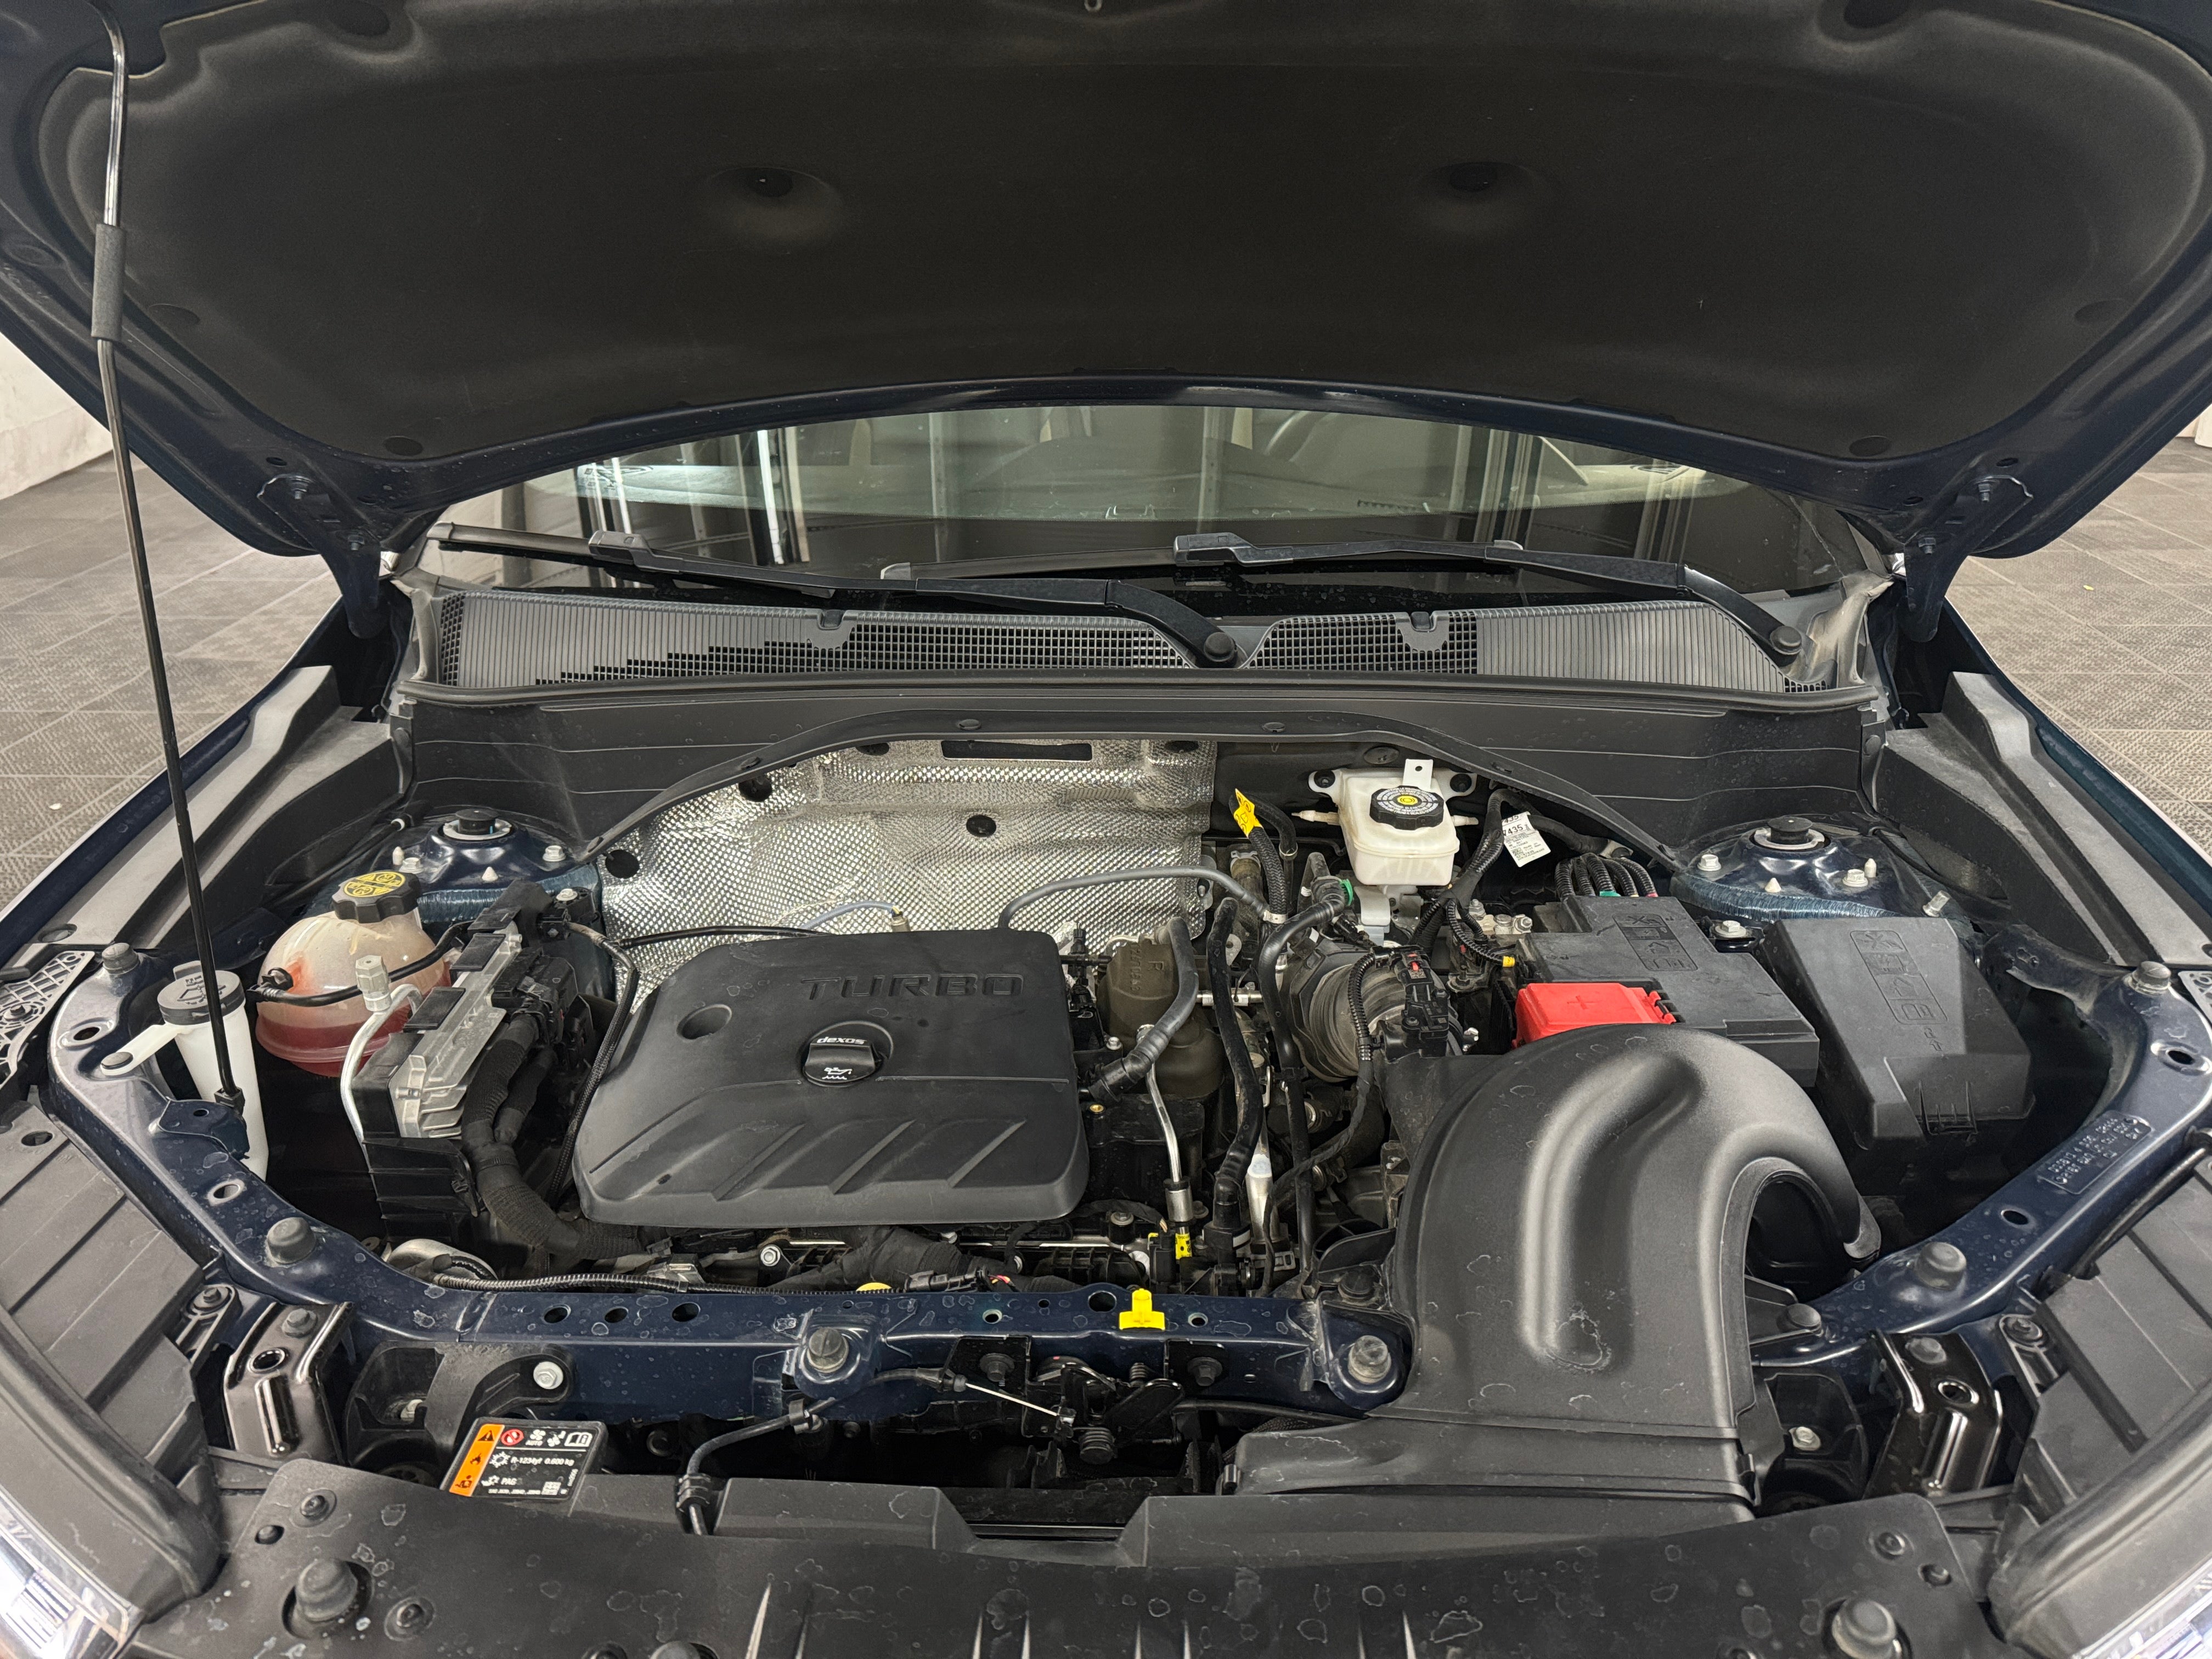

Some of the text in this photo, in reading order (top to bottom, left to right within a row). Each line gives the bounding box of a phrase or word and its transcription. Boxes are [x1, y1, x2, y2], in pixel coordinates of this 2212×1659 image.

[802, 973, 1024, 1000] TURBO
[816, 1036, 867, 1045] dexos
[510, 1456, 543, 1465] R-1234yf
[565, 1458, 575, 1466] kg
